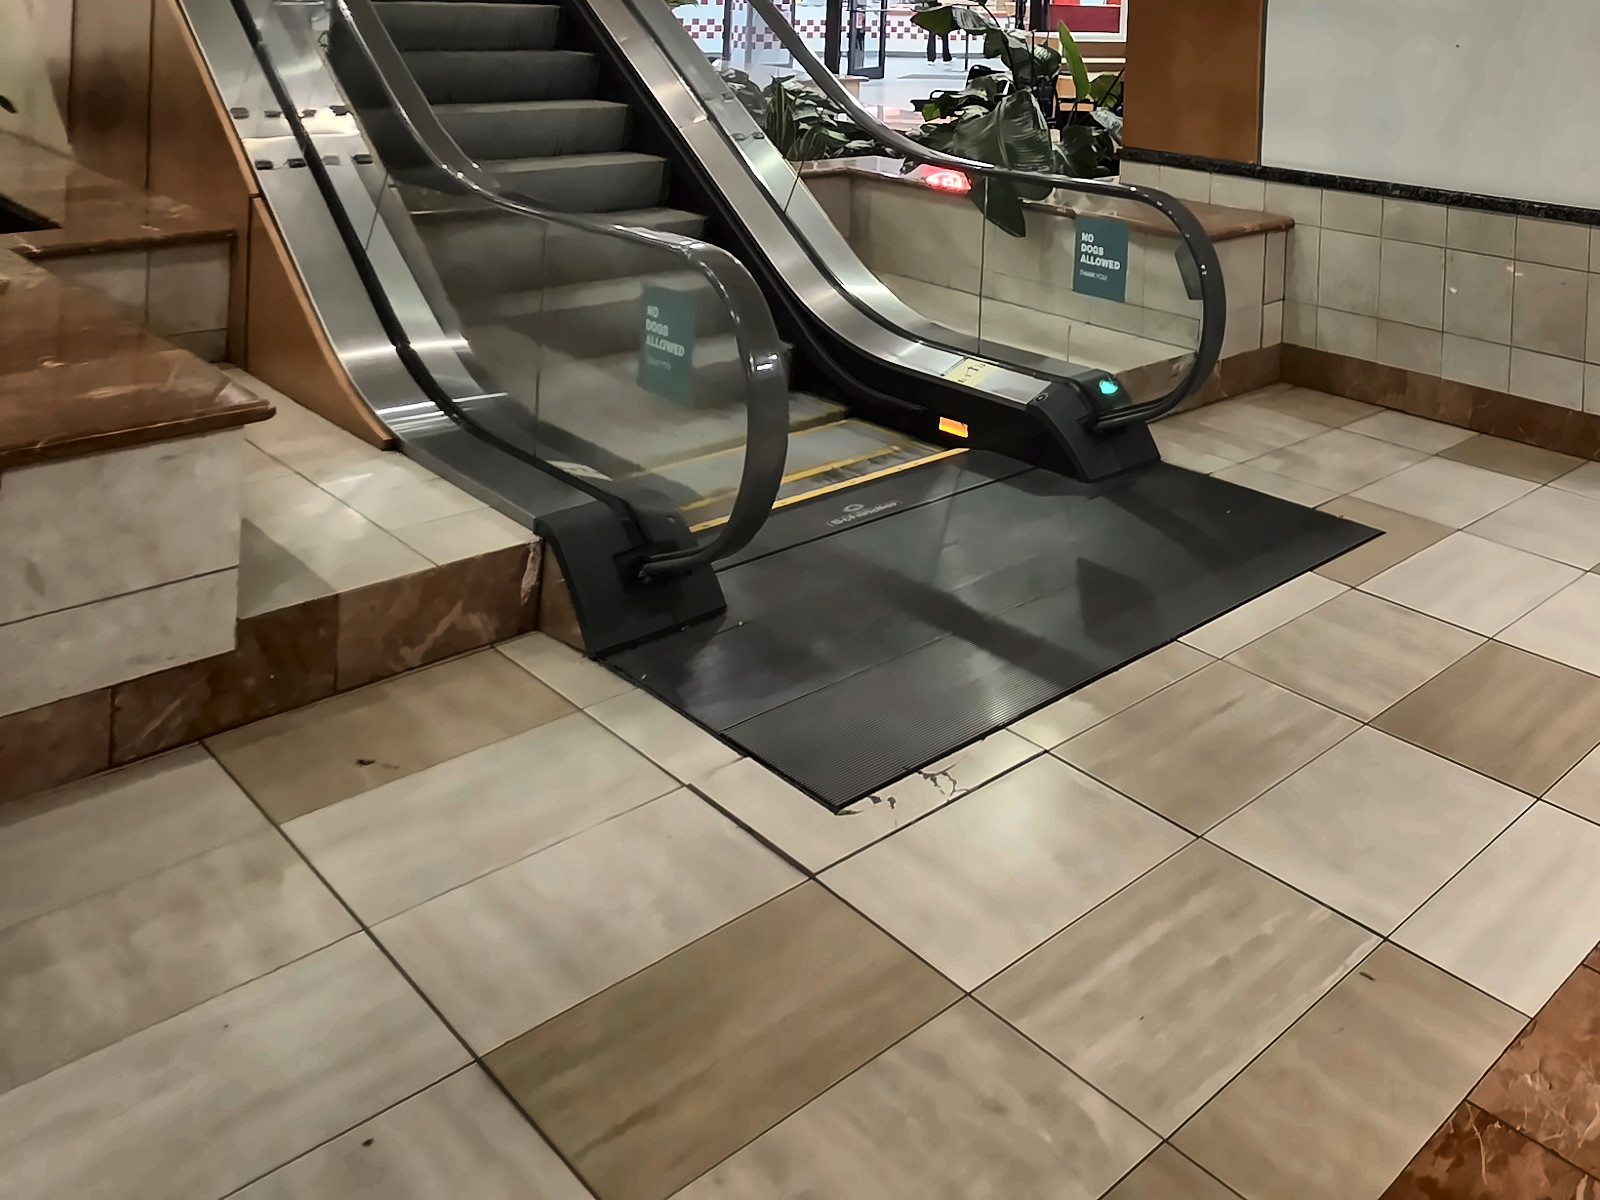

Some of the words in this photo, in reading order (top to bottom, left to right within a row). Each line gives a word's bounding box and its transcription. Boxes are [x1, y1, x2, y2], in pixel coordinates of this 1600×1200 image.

[1081, 232, 1094, 243] NO
[1080, 243, 1104, 256] DOGS
[1080, 254, 1121, 270] ALLOWED
[646, 305, 659, 318] NO
[645, 318, 669, 337] DOGS
[645, 334, 685, 357] ALLOWED
